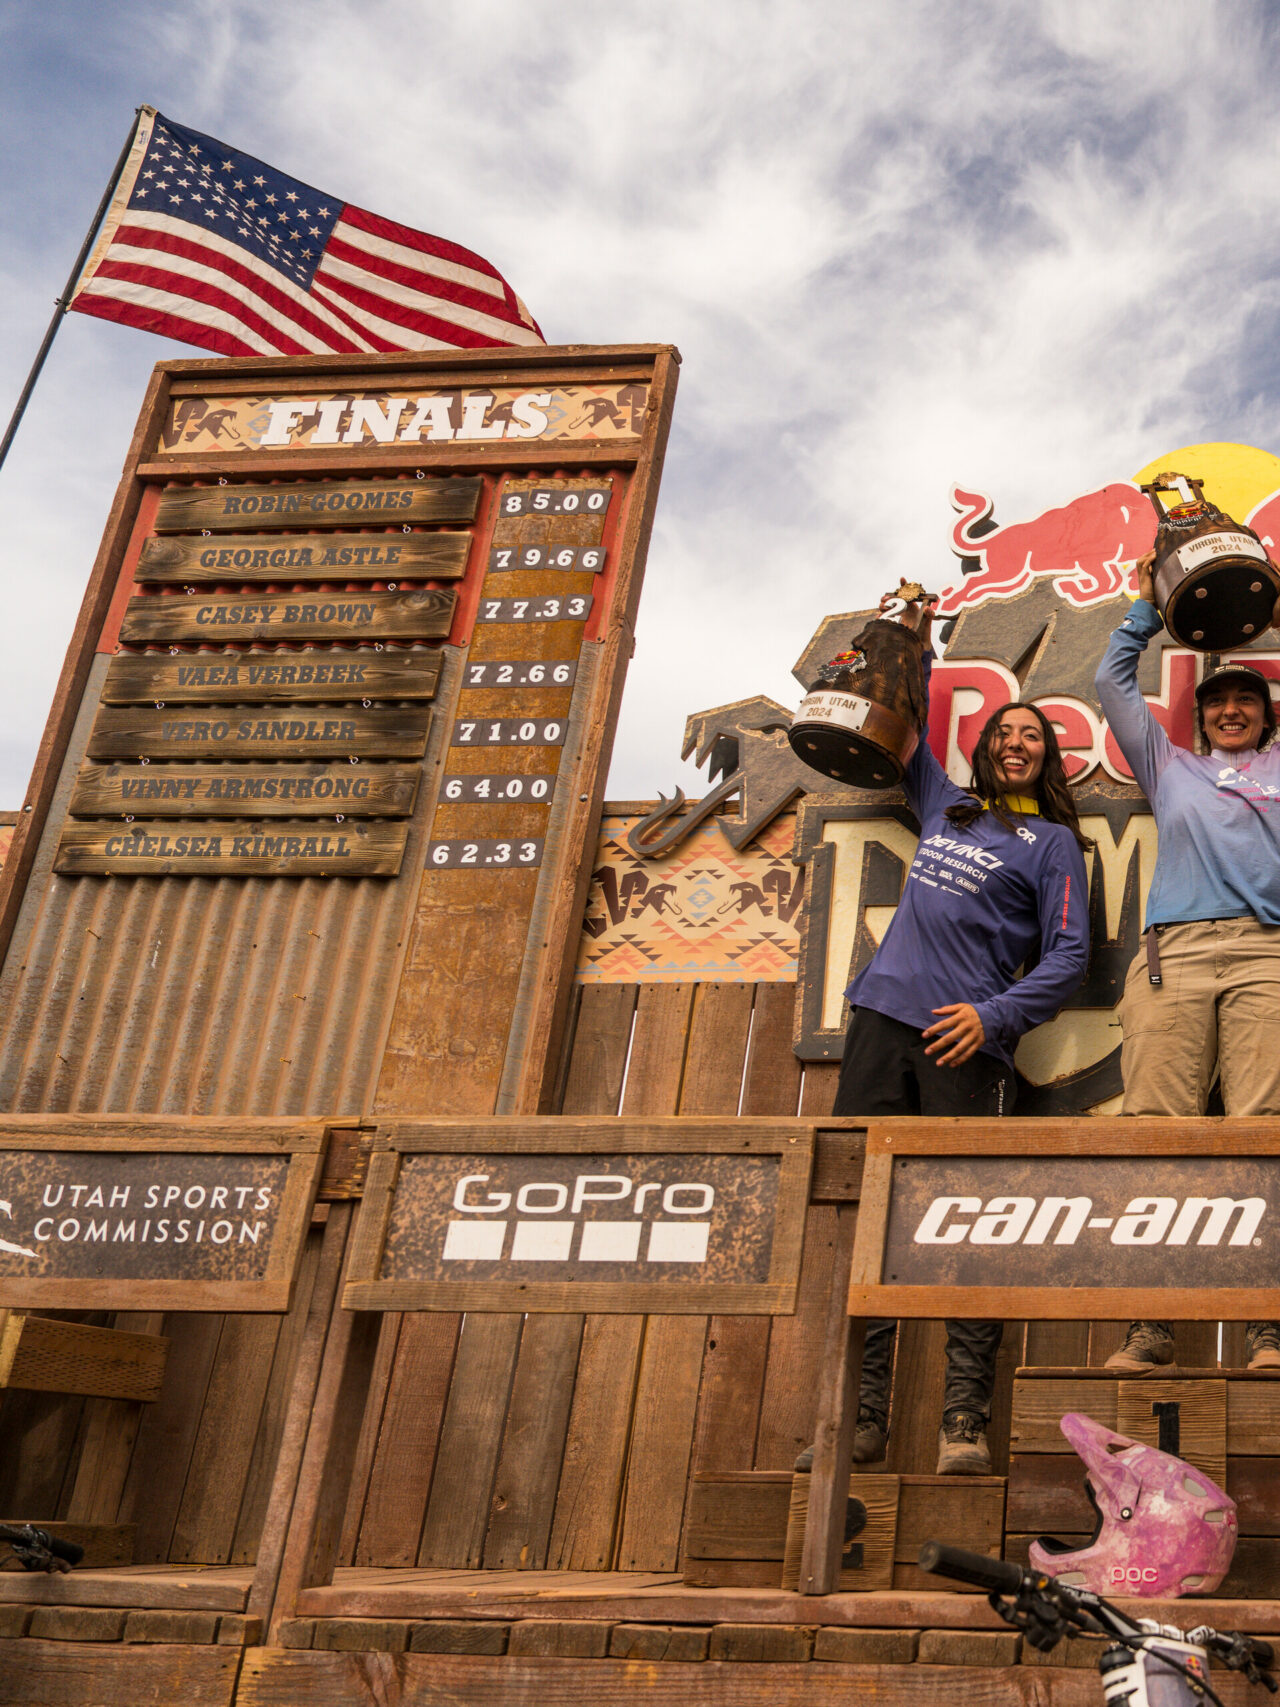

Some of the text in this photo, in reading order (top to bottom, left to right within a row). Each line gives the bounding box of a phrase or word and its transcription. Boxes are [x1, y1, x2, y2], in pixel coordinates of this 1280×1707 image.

[260, 393, 553, 446] FINALS
[1167, 476, 1194, 502] 1
[223, 491, 414, 515] ROBIN GOOMES
[506, 492, 604, 514] 85.00
[1188, 535, 1255, 553] VIRGIN UTAH
[1211, 544, 1242, 554] 2024
[200, 546, 400, 569] GEORGIA ASTLE
[496, 548, 600, 569] 79.66
[196, 603, 377, 625] CASEY BROWN
[484, 597, 586, 619] 77.33
[879, 597, 908, 623] 2
[177, 664, 369, 687] VAEA VERBEEK
[470, 664, 570, 684] 72.66
[806, 707, 833, 718] 2024
[829, 696, 858, 710] UTAH
[928, 654, 1197, 783] Red
[161, 720, 357, 742] VERO SANDLER
[458, 722, 562, 742] 71.00
[121, 777, 371, 800] VINNY ARMSTRONG
[445, 778, 548, 799] 64.00
[104, 836, 352, 858] CHELSEA KIMBALL
[1016, 827, 1037, 845] OR
[432, 842, 537, 865] 62.33
[923, 834, 1005, 870] DEVINCI
[943, 856, 988, 882] RESEARCH
[43, 1184, 272, 1210] UTAH SPORTS
[453, 1174, 715, 1215] GoPro
[34, 1217, 262, 1245] COMMISSION
[913, 1196, 1267, 1246] can-am
